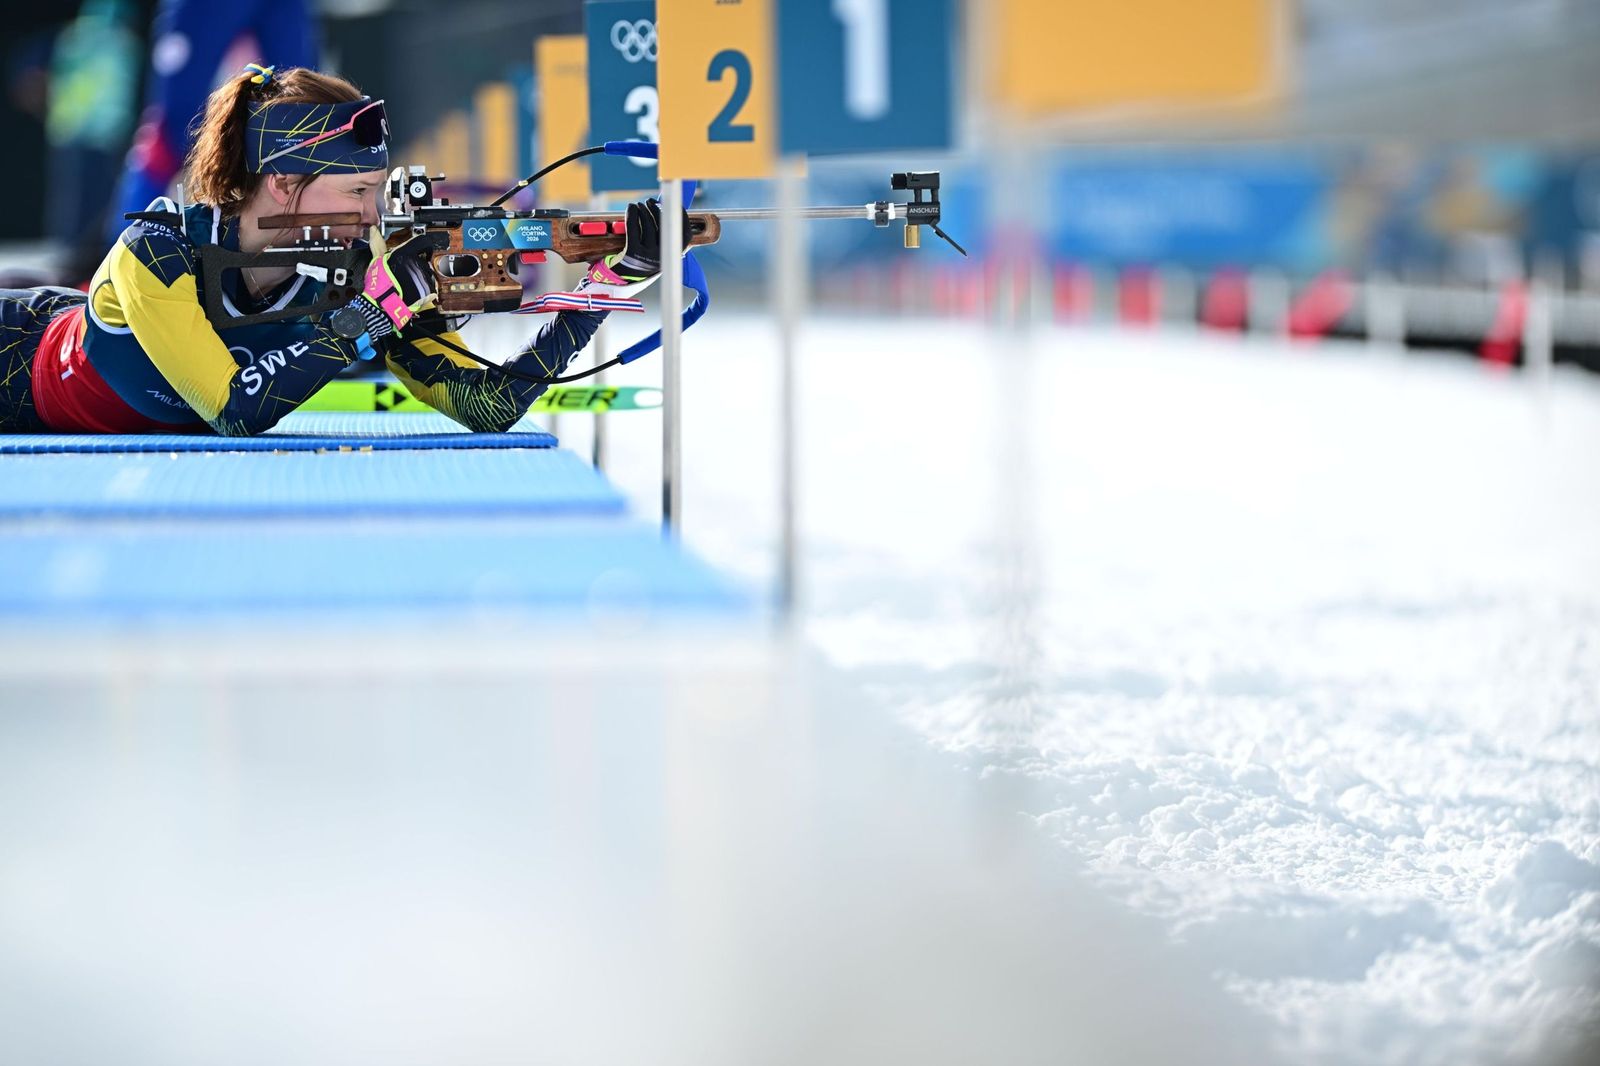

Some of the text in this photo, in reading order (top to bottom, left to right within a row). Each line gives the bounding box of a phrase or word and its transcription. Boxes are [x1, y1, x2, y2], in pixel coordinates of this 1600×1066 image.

[706, 50, 755, 142] 2
[834, 0, 890, 118] 1
[624, 85, 659, 167] 3
[241, 341, 309, 396] SWE
